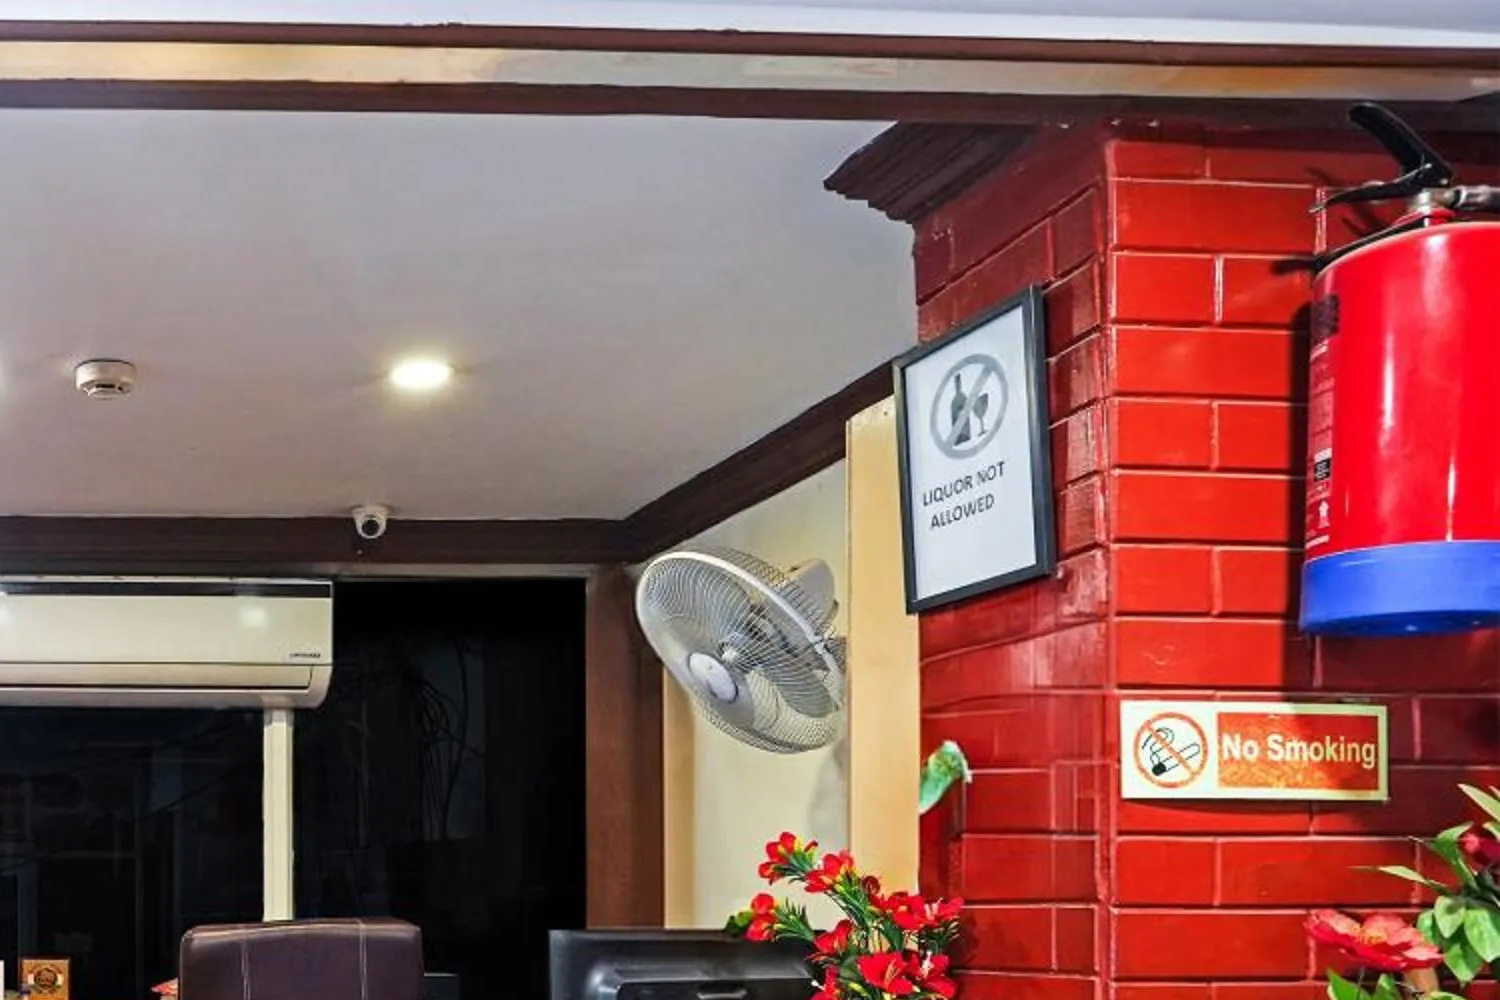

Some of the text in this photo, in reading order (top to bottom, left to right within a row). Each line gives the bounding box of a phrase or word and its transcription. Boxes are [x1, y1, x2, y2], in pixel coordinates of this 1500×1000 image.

[922, 461, 1005, 507] LIQUOR NOT
[930, 493, 995, 529] ALLOWED
[1221, 732, 1375, 769] No Smoking
